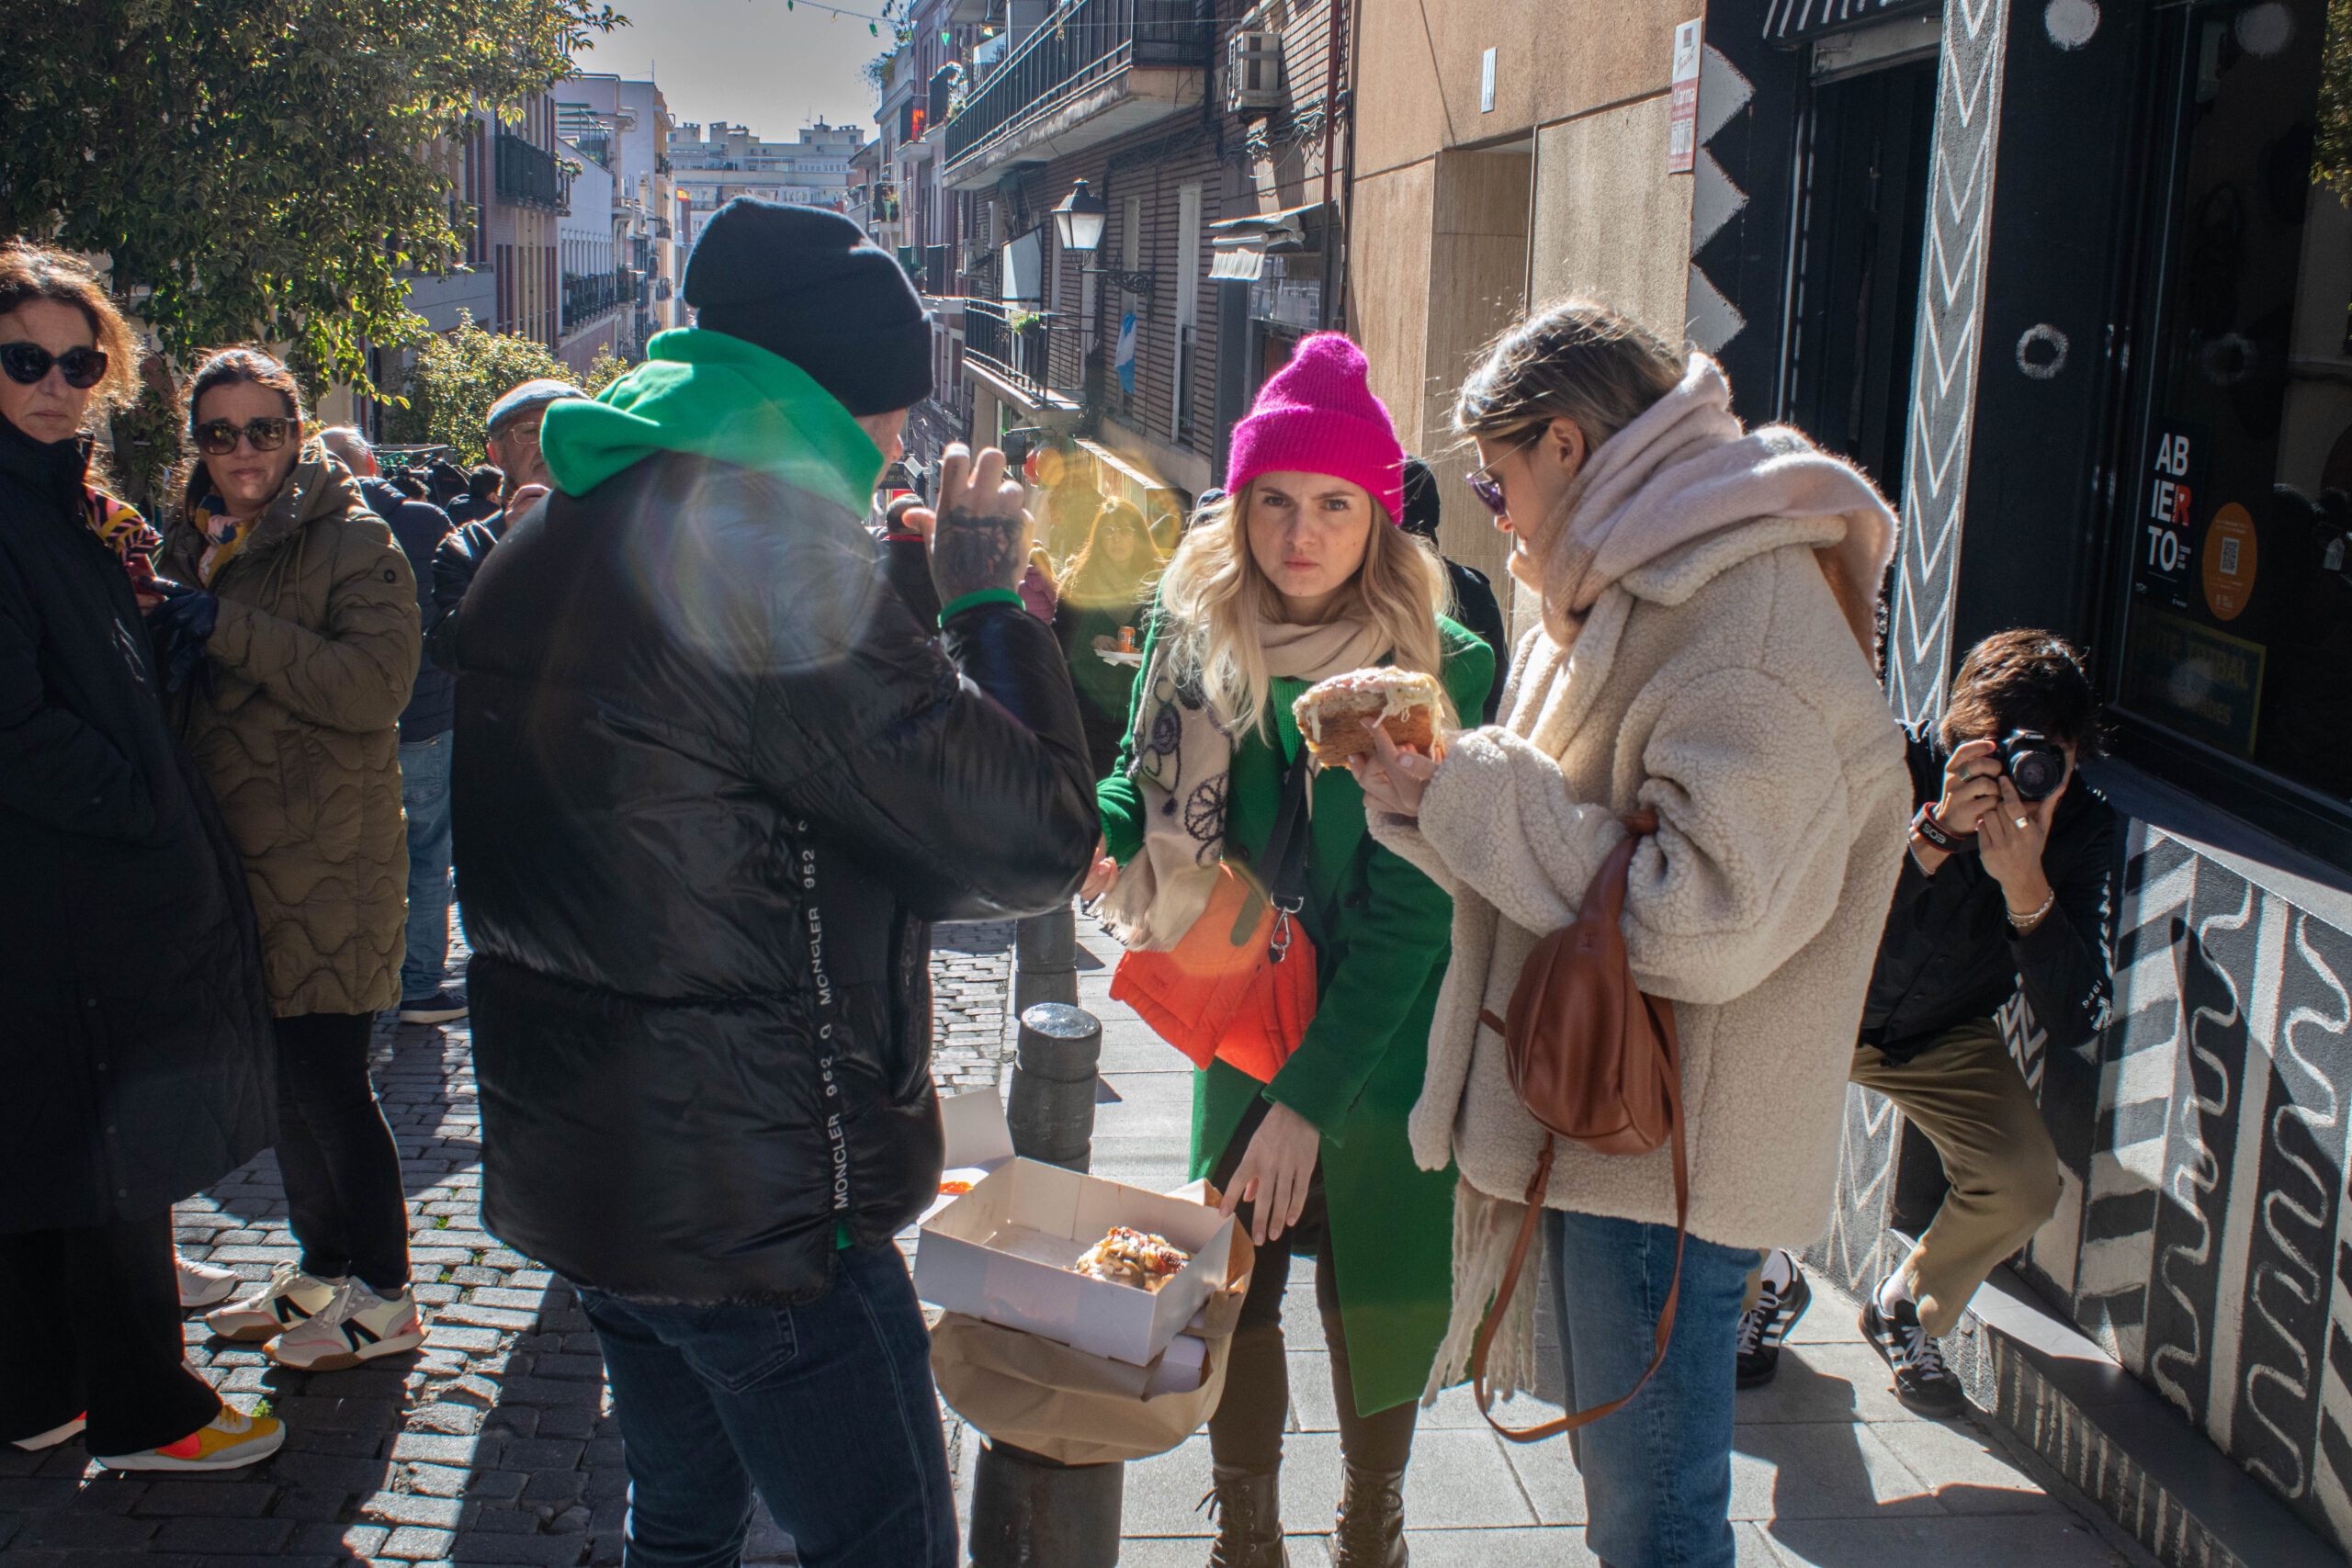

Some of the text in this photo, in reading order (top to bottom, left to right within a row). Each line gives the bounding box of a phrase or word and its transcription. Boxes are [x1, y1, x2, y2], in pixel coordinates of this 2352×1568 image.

[1673, 86, 1695, 106] Alarma
[2154, 433, 2190, 477] AB
[2151, 479, 2191, 527] IER
[2147, 525, 2178, 571] TO
[1922, 823, 1947, 844] EOS
[803, 849, 815, 888] 952
[808, 907, 831, 1006] MONCLER
[820, 1055, 838, 1097] 952
[828, 1112, 850, 1210] MONCLER
